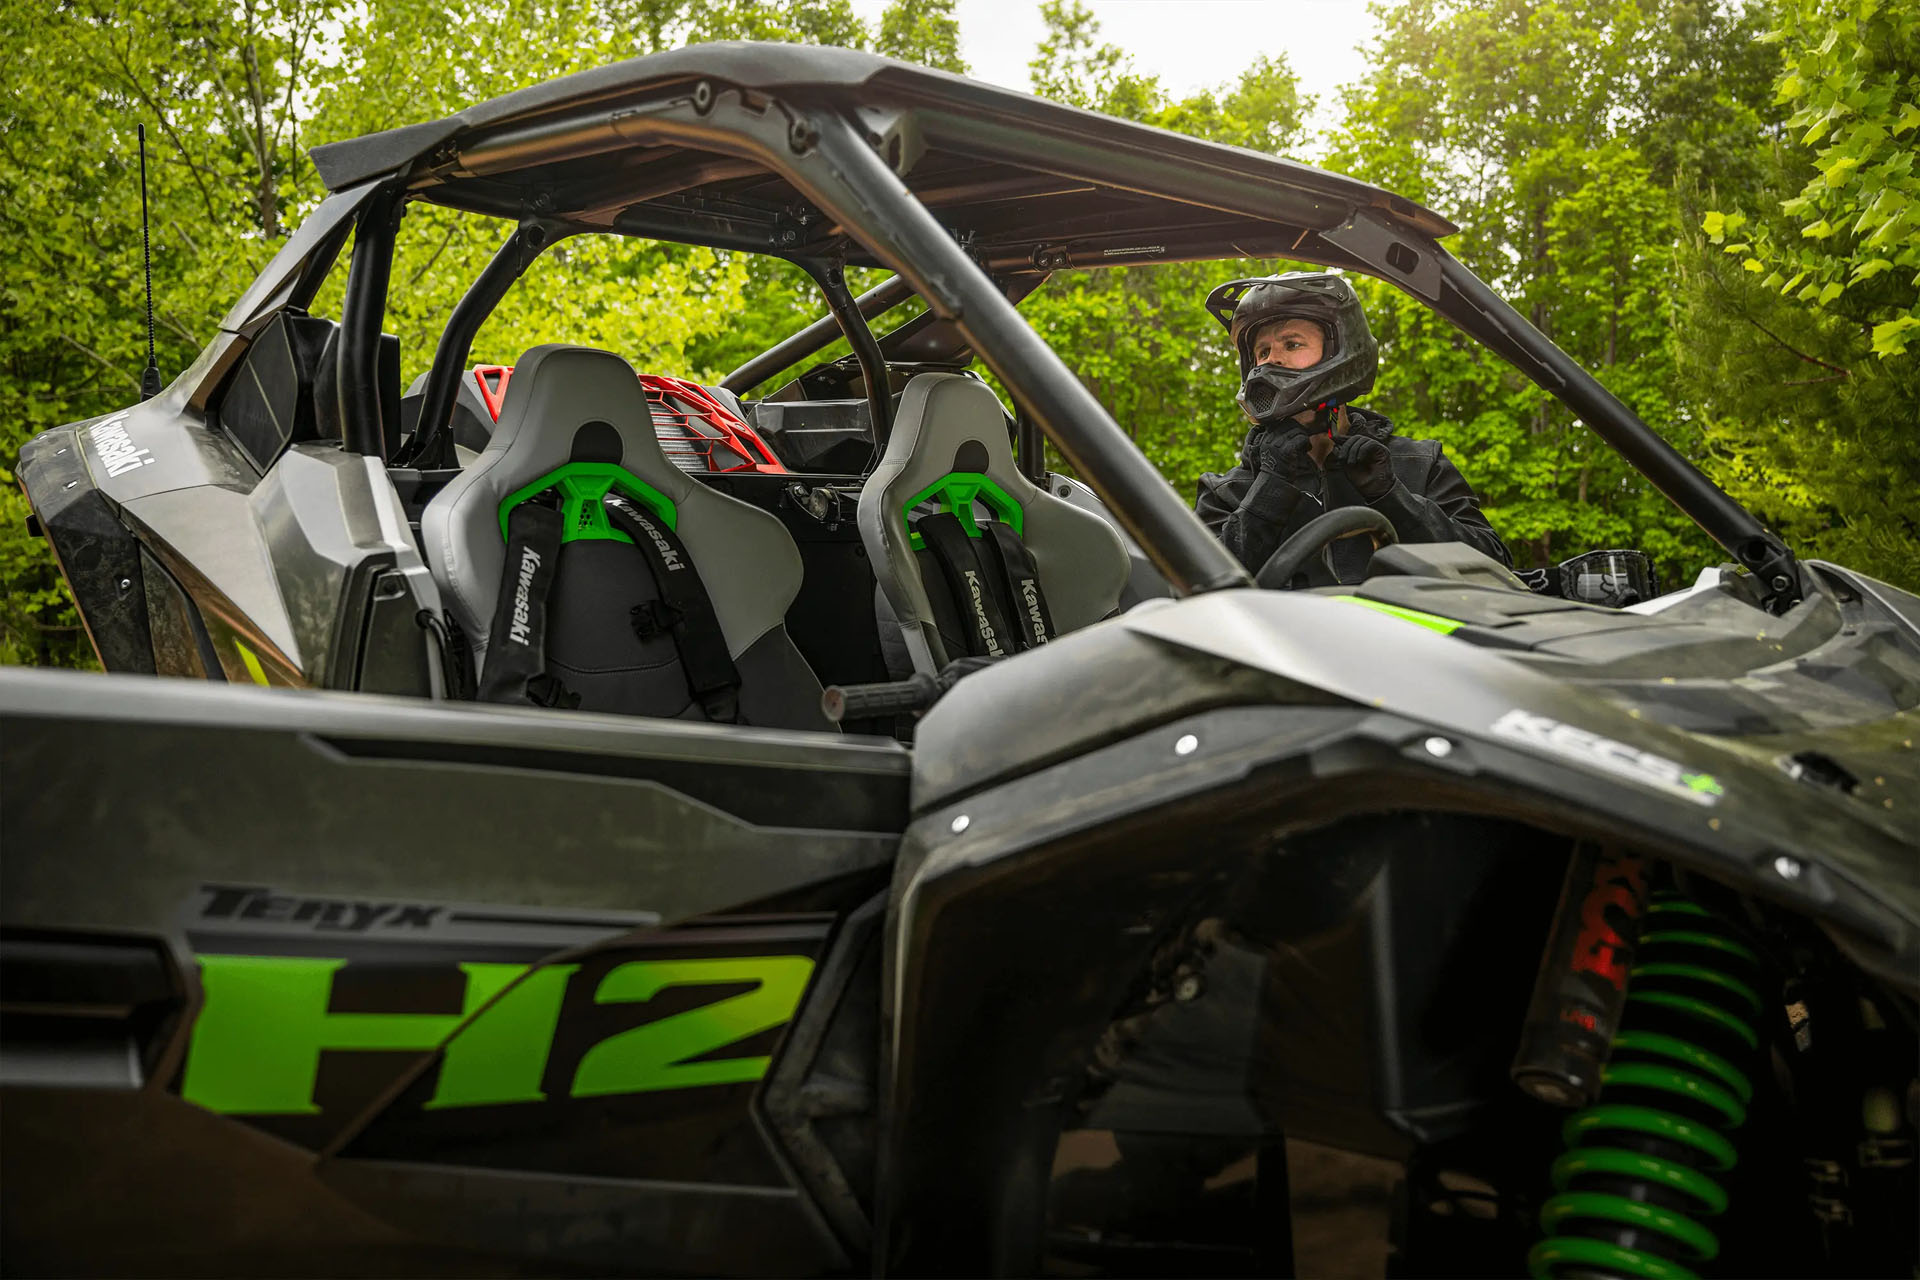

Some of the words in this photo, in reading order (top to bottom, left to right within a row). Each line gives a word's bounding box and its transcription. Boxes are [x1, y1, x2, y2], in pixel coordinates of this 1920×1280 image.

[89, 411, 155, 478] Kawasaki
[604, 498, 685, 571] Kawasaki
[509, 545, 541, 646] Kawasaki
[182, 953, 816, 1115] H2
